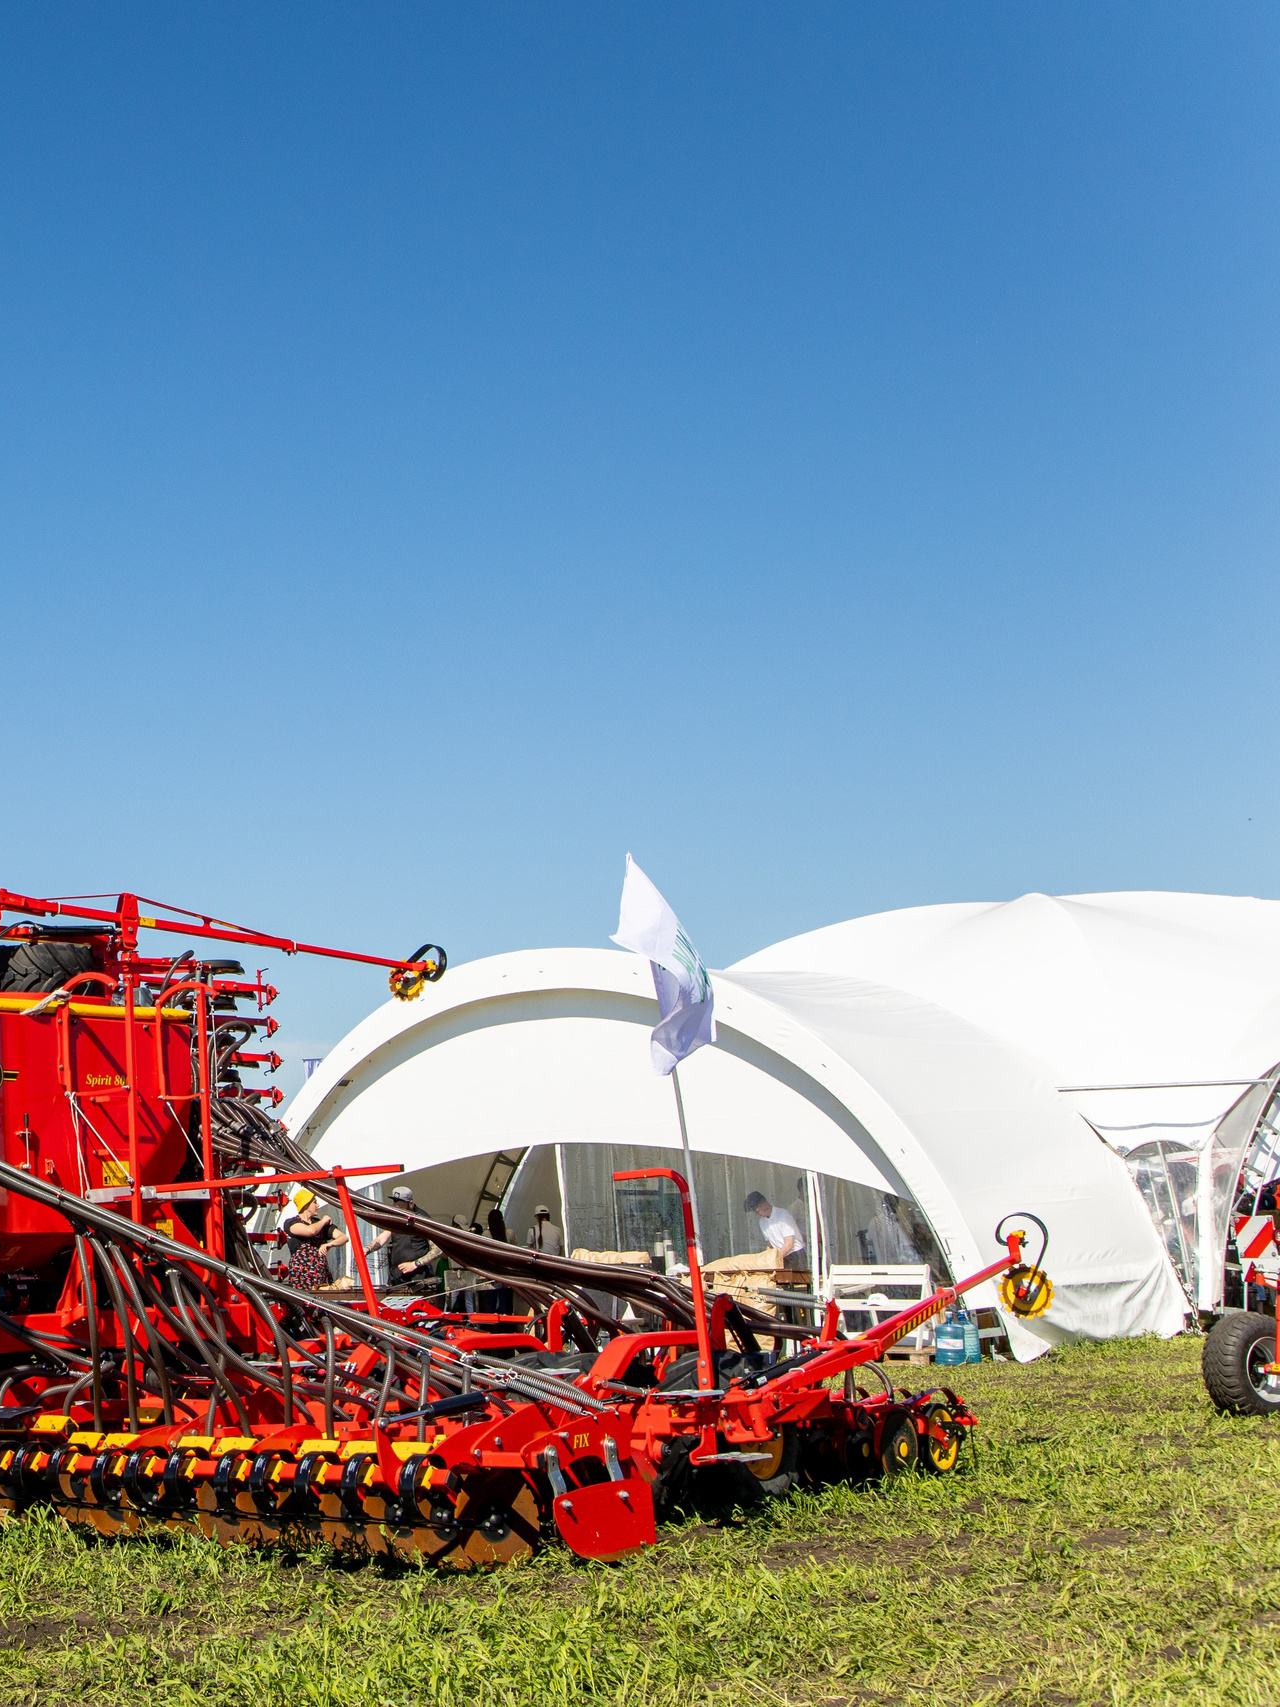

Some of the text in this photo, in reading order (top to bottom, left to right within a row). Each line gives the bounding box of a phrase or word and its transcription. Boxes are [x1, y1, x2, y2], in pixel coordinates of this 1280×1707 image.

[85, 1074, 128, 1087] Spirit 80
[573, 1433, 590, 1449] FIX
